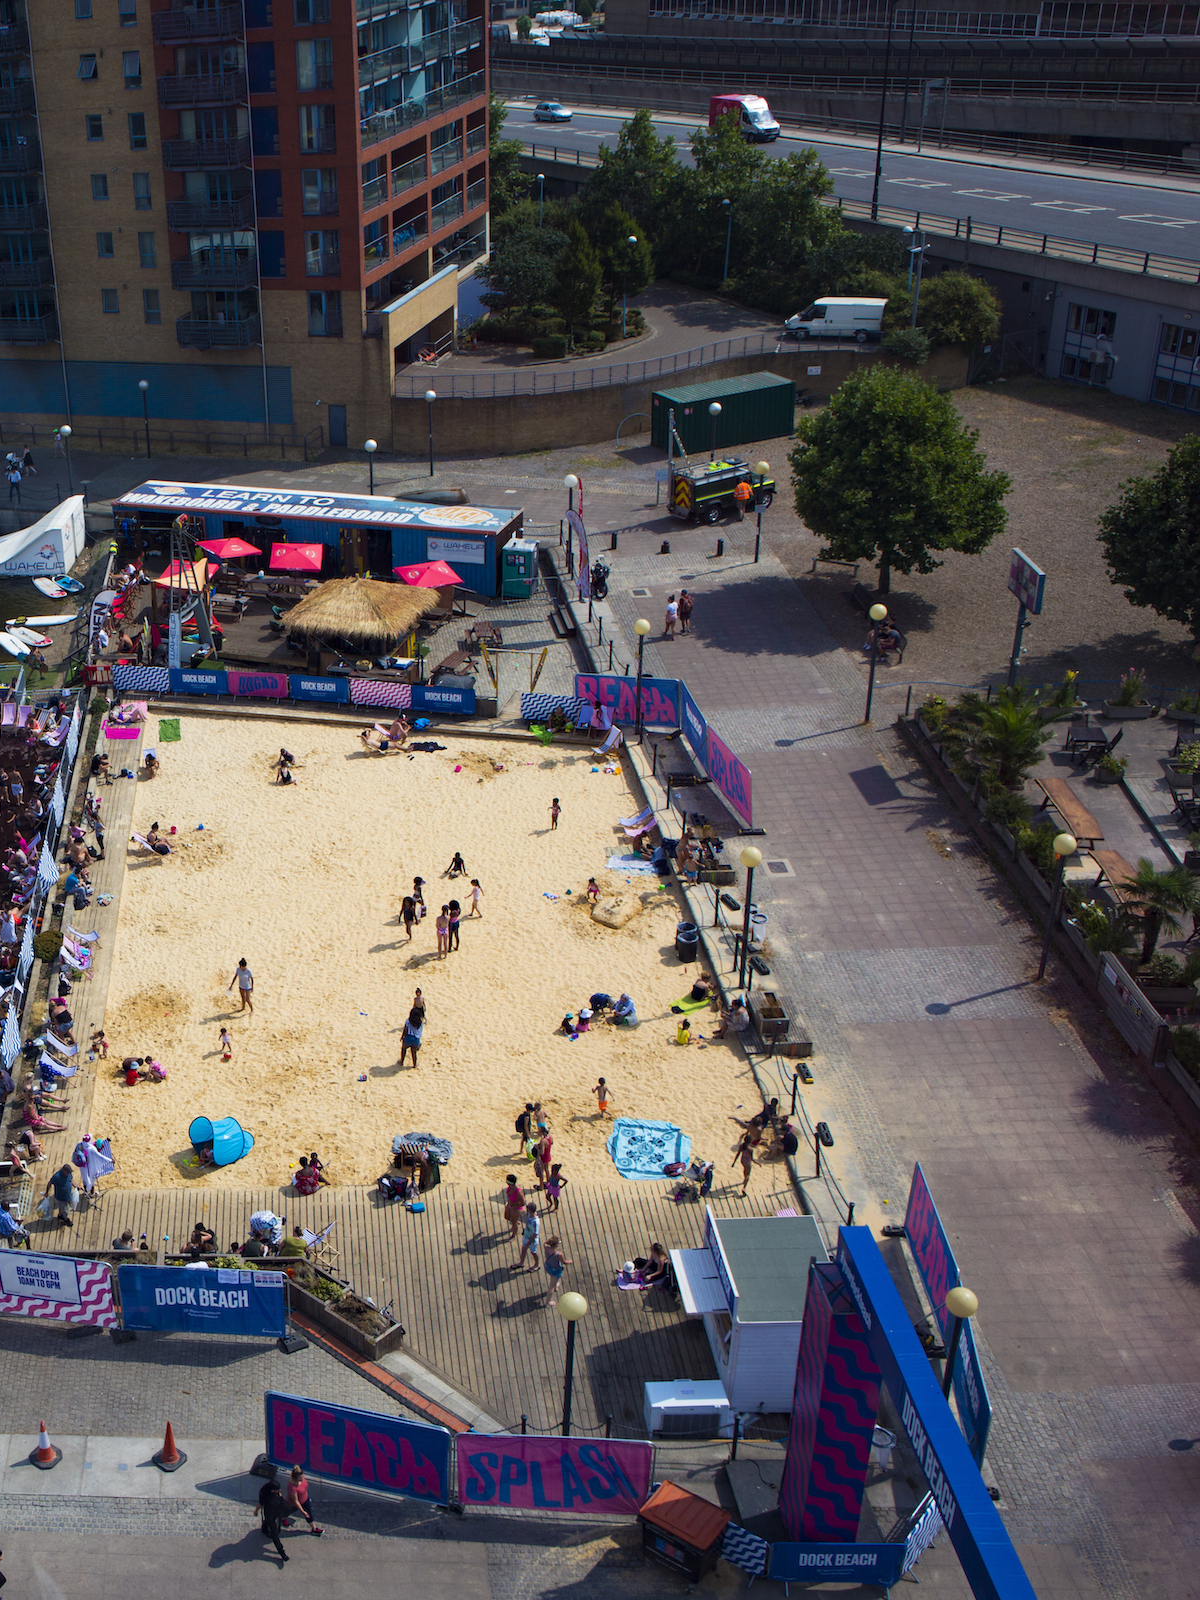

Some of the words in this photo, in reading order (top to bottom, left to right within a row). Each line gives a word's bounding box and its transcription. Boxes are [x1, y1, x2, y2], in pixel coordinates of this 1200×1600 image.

[200, 490, 293, 503] LEARN
[299, 496, 335, 506] TO
[119, 492, 243, 510] WAKEBOARD
[241, 503, 260, 512] &
[261, 503, 415, 523] PADDLEBOARD
[443, 542, 486, 550] WAKEUP
[4, 561, 65, 571] WAKEUP
[182, 674, 197, 682] DOCK
[198, 674, 216, 683] BEACH
[301, 681, 316, 690] DOCK
[317, 682, 336, 691] BEACH
[425, 692, 441, 701] DOCK
[442, 693, 461, 702] BEACH
[16, 1266, 39, 1278] BEACH
[40, 1269, 59, 1280] OPEN
[18, 1276, 36, 1287] 10AM
[36, 1279, 46, 1288] TO
[46, 1280, 61, 1289] 6PM
[155, 1286, 197, 1306] DOCK
[199, 1288, 249, 1308] BEACH
[272, 1400, 441, 1499] BEACH
[466, 1444, 640, 1508] SPLASH
[902, 1392, 927, 1464] DOCK
[924, 1444, 956, 1530] BEACH
[799, 1553, 833, 1566] DOCK
[834, 1553, 878, 1566] BEACH
